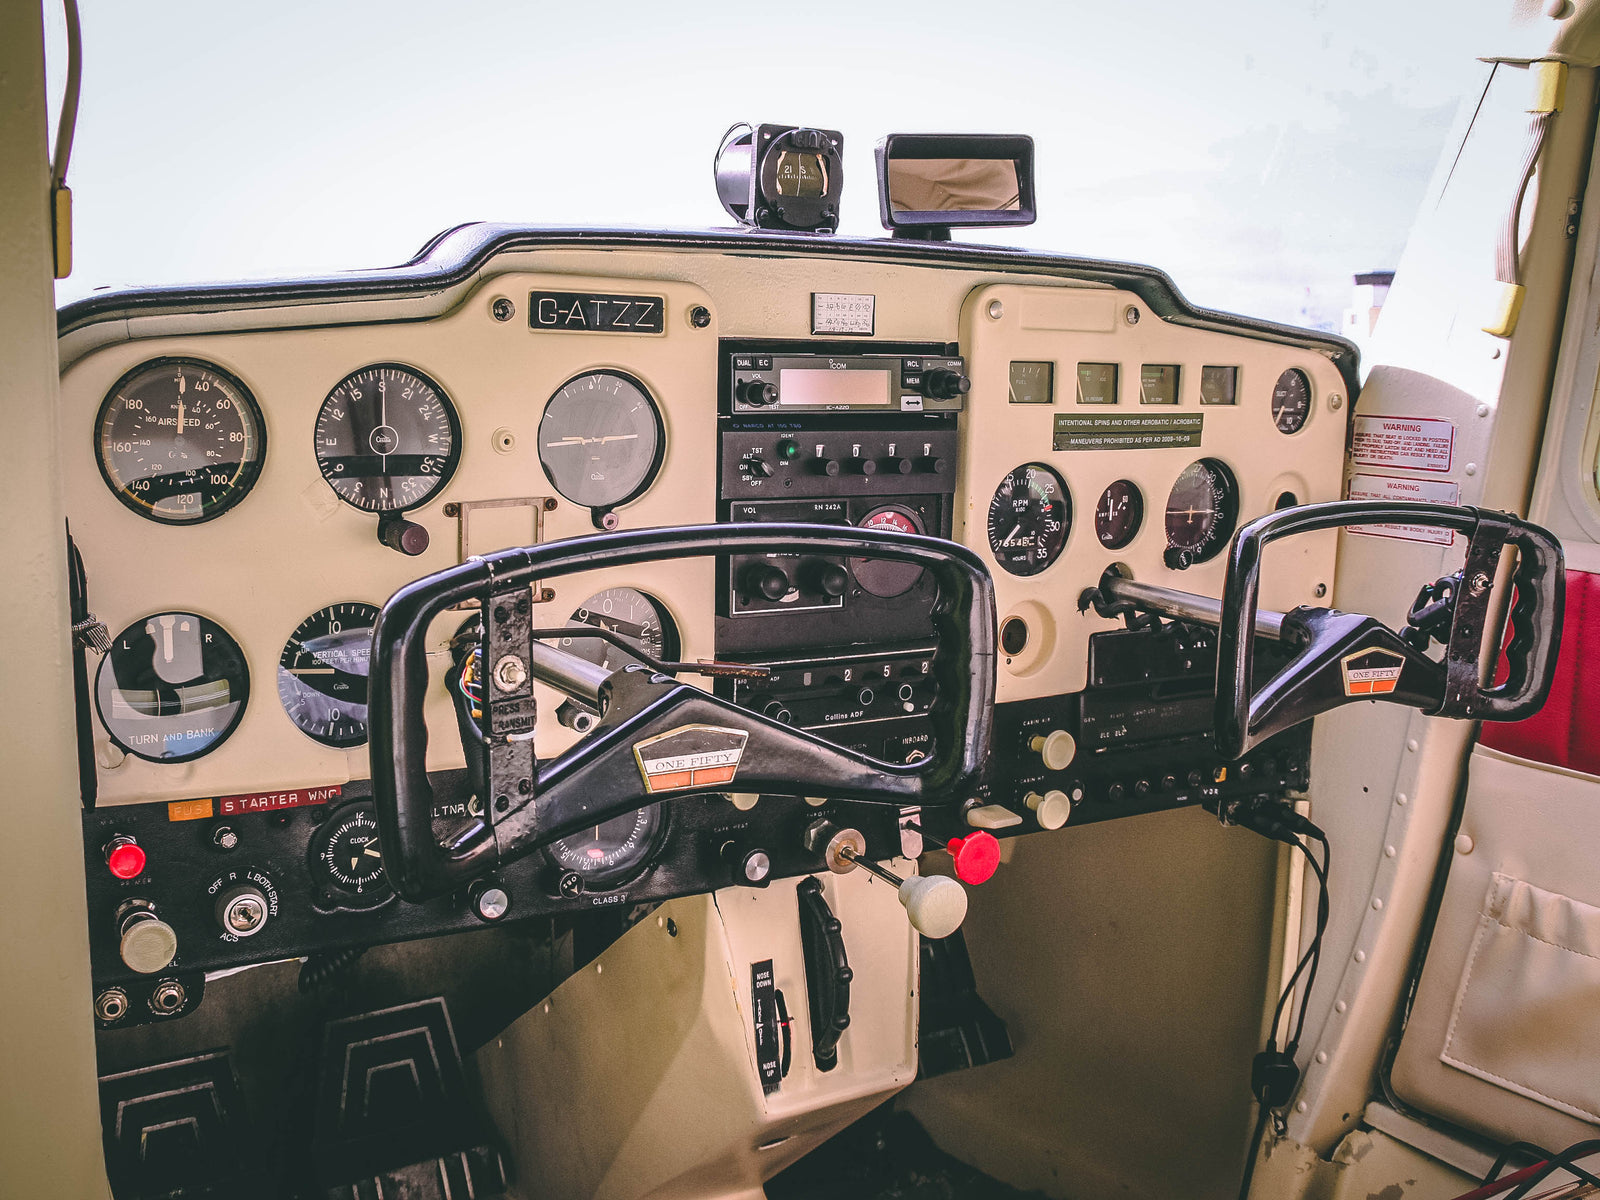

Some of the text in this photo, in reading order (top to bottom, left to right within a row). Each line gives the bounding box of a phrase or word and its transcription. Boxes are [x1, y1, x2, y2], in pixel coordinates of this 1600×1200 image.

[785, 165, 792, 173] 21
[800, 166, 806, 174] S
[538, 298, 655, 327] G-ATZZ
[195, 381, 210, 391] 40
[378, 382, 386, 392] S
[350, 389, 363, 401] 15
[402, 388, 414, 400] 21
[125, 400, 143, 410] 180
[216, 400, 231, 410] 60
[331, 408, 344, 421] 12
[419, 405, 431, 421] 24
[158, 418, 200, 427] AIRSEED
[1383, 423, 1422, 432] WARNING
[229, 432, 243, 442] 80
[326, 438, 337, 446] E
[428, 434, 438, 444] W
[113, 442, 132, 453] 160
[816, 445, 823, 458] 7
[853, 446, 859, 457] 0
[421, 457, 434, 473] 30
[1193, 464, 1202, 473] 27
[1026, 469, 1036, 479] 20
[1208, 471, 1216, 482] 30
[210, 474, 228, 485] 100
[132, 480, 150, 491] 140
[353, 482, 363, 492] 3
[401, 478, 417, 492] 33
[1045, 483, 1055, 494] 25
[1387, 483, 1420, 492] WARNING
[380, 488, 388, 498] N
[1217, 488, 1224, 500] 33
[177, 494, 194, 504] 120
[1013, 500, 1028, 508] RPM
[1050, 521, 1060, 532] 30
[1037, 549, 1048, 559] 35
[603, 599, 612, 614] 0
[579, 608, 589, 623] 9
[329, 621, 342, 635] 10
[641, 621, 651, 636] 2
[205, 634, 213, 643] R
[123, 640, 131, 650] L
[312, 650, 347, 659] VERTICAL
[844, 661, 928, 682] 2 5 2
[493, 703, 520, 713] PRESS
[328, 708, 340, 721] 10
[825, 713, 848, 721] Collins
[494, 717, 536, 730] TRANSMIT
[128, 727, 215, 745] TURN AND BANK
[656, 754, 732, 770] ONE FIFTY
[225, 793, 298, 811] STARTER
[350, 836, 369, 844] CLOCK
[229, 872, 237, 880] R
[247, 871, 253, 879] L
[208, 878, 223, 894] OFF
[253, 873, 274, 892] BOTH
[268, 891, 278, 917] START
[593, 895, 618, 905] CLASS
[220, 933, 239, 943] ACS
[757, 971, 769, 979] NOSE
[756, 980, 772, 988] DOWN
[763, 1061, 776, 1070] NOSE
[767, 1069, 774, 1077] UP
